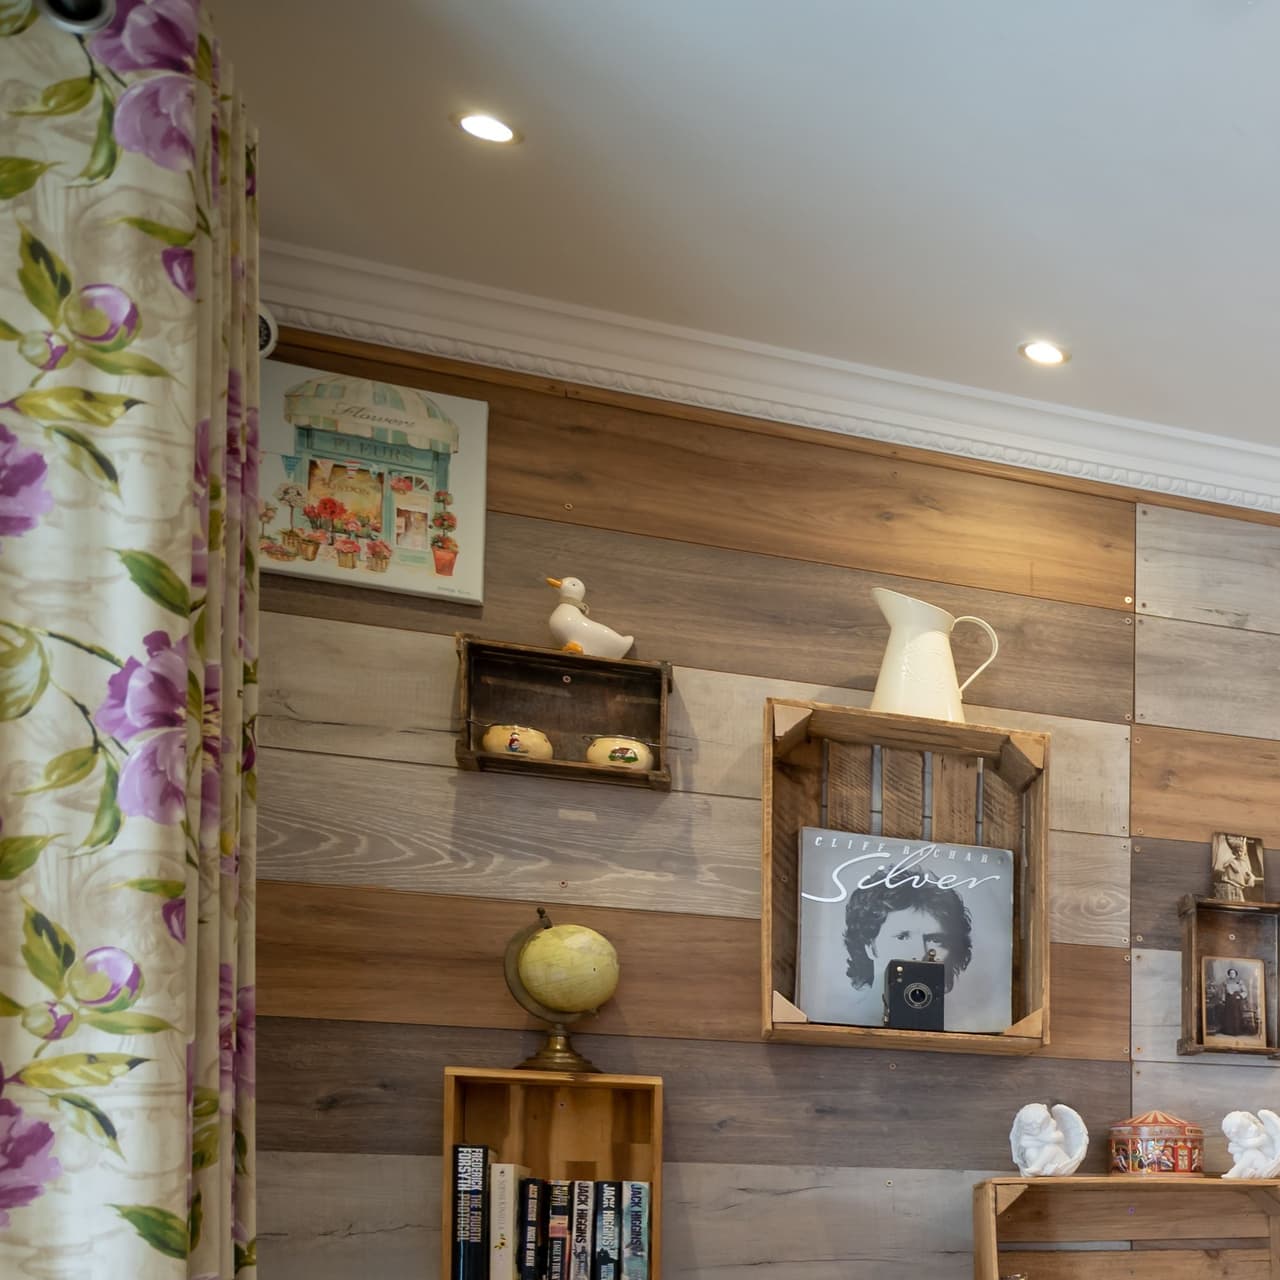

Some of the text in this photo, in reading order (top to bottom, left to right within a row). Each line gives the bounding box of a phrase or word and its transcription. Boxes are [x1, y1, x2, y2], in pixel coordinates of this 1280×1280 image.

[802, 844, 1000, 903] Silver
[815, 836, 885, 852] CLIFF
[457, 1147, 472, 1243] FORSYTH PROTOCOL
[469, 1148, 483, 1243] FREDERICK THE FOURTH
[529, 1184, 537, 1198] JACK
[577, 1183, 589, 1206] JACK
[602, 1184, 616, 1246] JACK HIGGINS
[631, 1184, 642, 1246] JACK HIGGINS
[576, 1208, 587, 1243] HIGGINS
